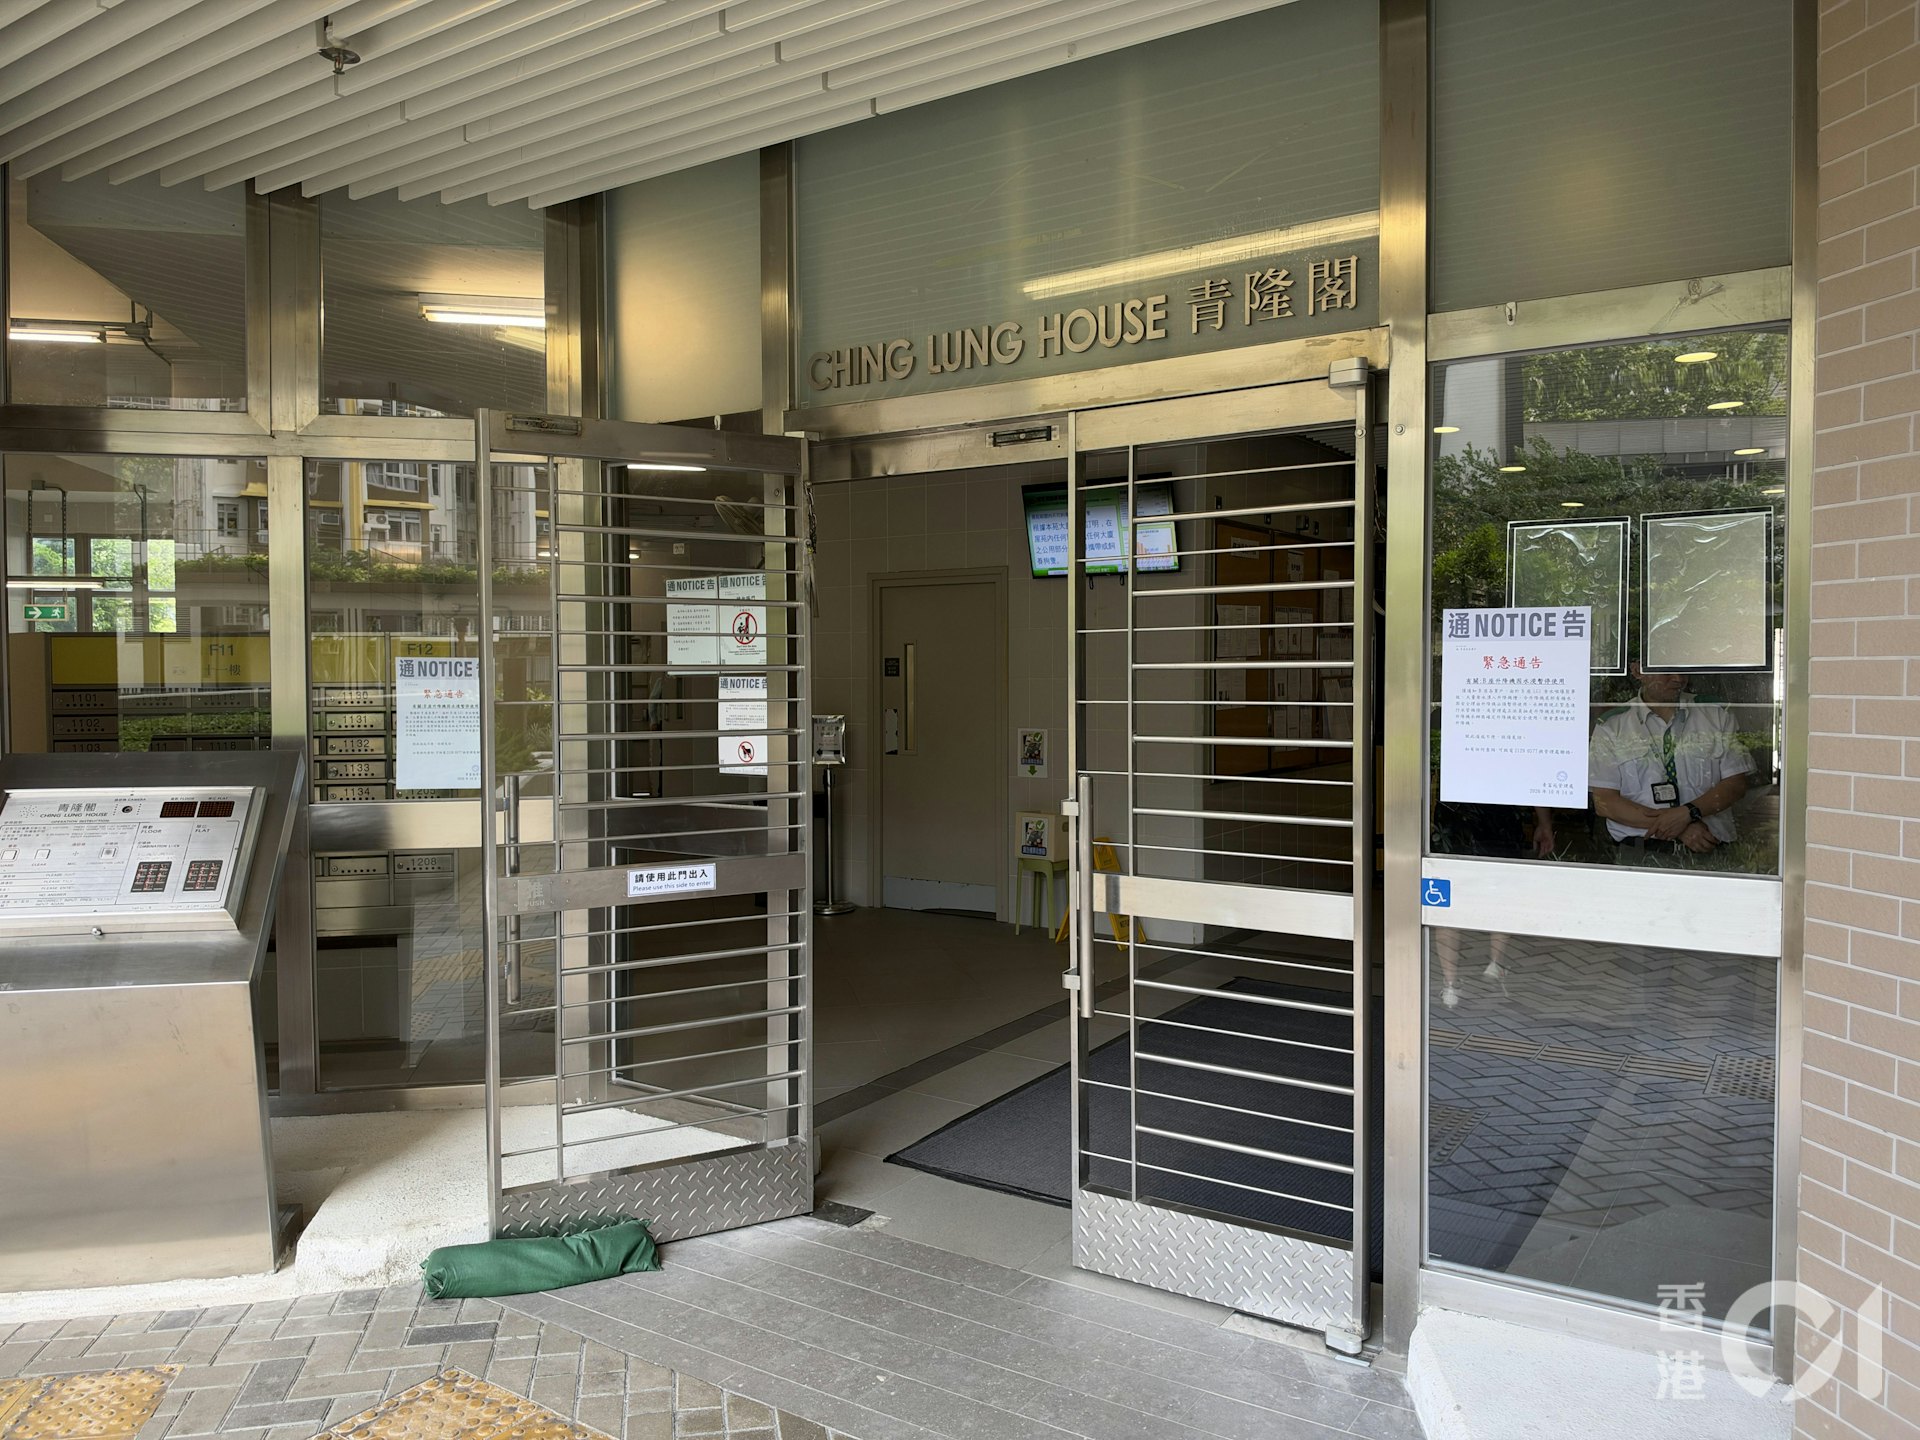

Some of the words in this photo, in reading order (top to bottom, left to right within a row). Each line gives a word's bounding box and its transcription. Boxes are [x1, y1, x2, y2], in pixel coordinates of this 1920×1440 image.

[806, 338, 914, 392] CHING
[926, 320, 1024, 376] LUNG
[1037, 293, 1169, 359] HOUSE
[1184, 254, 1359, 334] 青隆閣
[667, 581, 675, 592] 通
[676, 580, 705, 591] NOTICE
[707, 579, 715, 590] 告
[729, 576, 760, 587] NOTICE
[1448, 612, 1470, 639] 通
[1474, 612, 1557, 639] NOTICE
[1562, 609, 1586, 639] 告
[209, 644, 235, 656] F11
[407, 644, 433, 656] F12
[1482, 655, 1544, 670] 緊急通告
[399, 659, 415, 678] 通
[417, 661, 473, 678] NOTICE
[720, 678, 728, 689] 通
[729, 678, 760, 689] NOTICE
[71, 694, 97, 702] 1101
[342, 691, 369, 700] 1130
[423, 689, 464, 699] 緊急通告
[71, 719, 100, 728] 1102
[343, 715, 368, 724] 1131
[343, 740, 370, 748] 1132
[344, 764, 370, 772] 1133
[344, 788, 370, 797] 1134
[411, 857, 437, 866] 1208
[635, 869, 708, 884] 請使用此門出入
